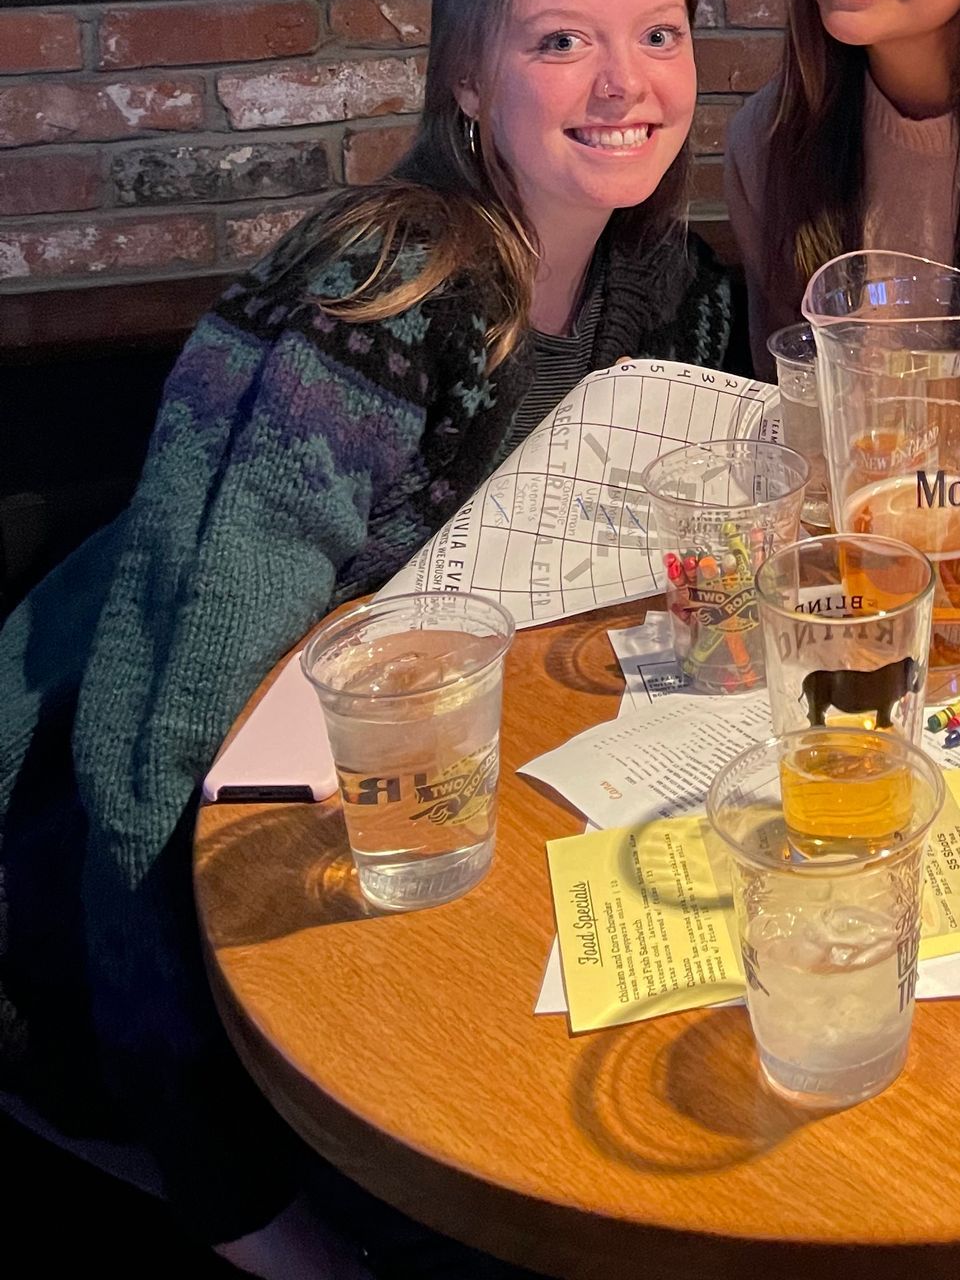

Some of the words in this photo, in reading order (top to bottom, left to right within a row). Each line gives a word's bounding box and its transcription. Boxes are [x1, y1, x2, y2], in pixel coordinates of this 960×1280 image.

[444, 559, 464, 592] EVE
[698, 590, 727, 604] TWO
[725, 588, 757, 616] ROA
[430, 777, 464, 798] TWO
[935, 832, 954, 858] Shots
[566, 879, 598, 930] Specials
[603, 903, 616, 933] Chowder
[574, 931, 599, 966] Food
[609, 934, 619, 953] Corn
[634, 919, 649, 956] Sandwich
[611, 953, 623, 969] and
[641, 957, 653, 973] Fish
[682, 958, 696, 988] Cubano
[614, 970, 629, 1003] Chicken
[646, 974, 658, 997] Fried
